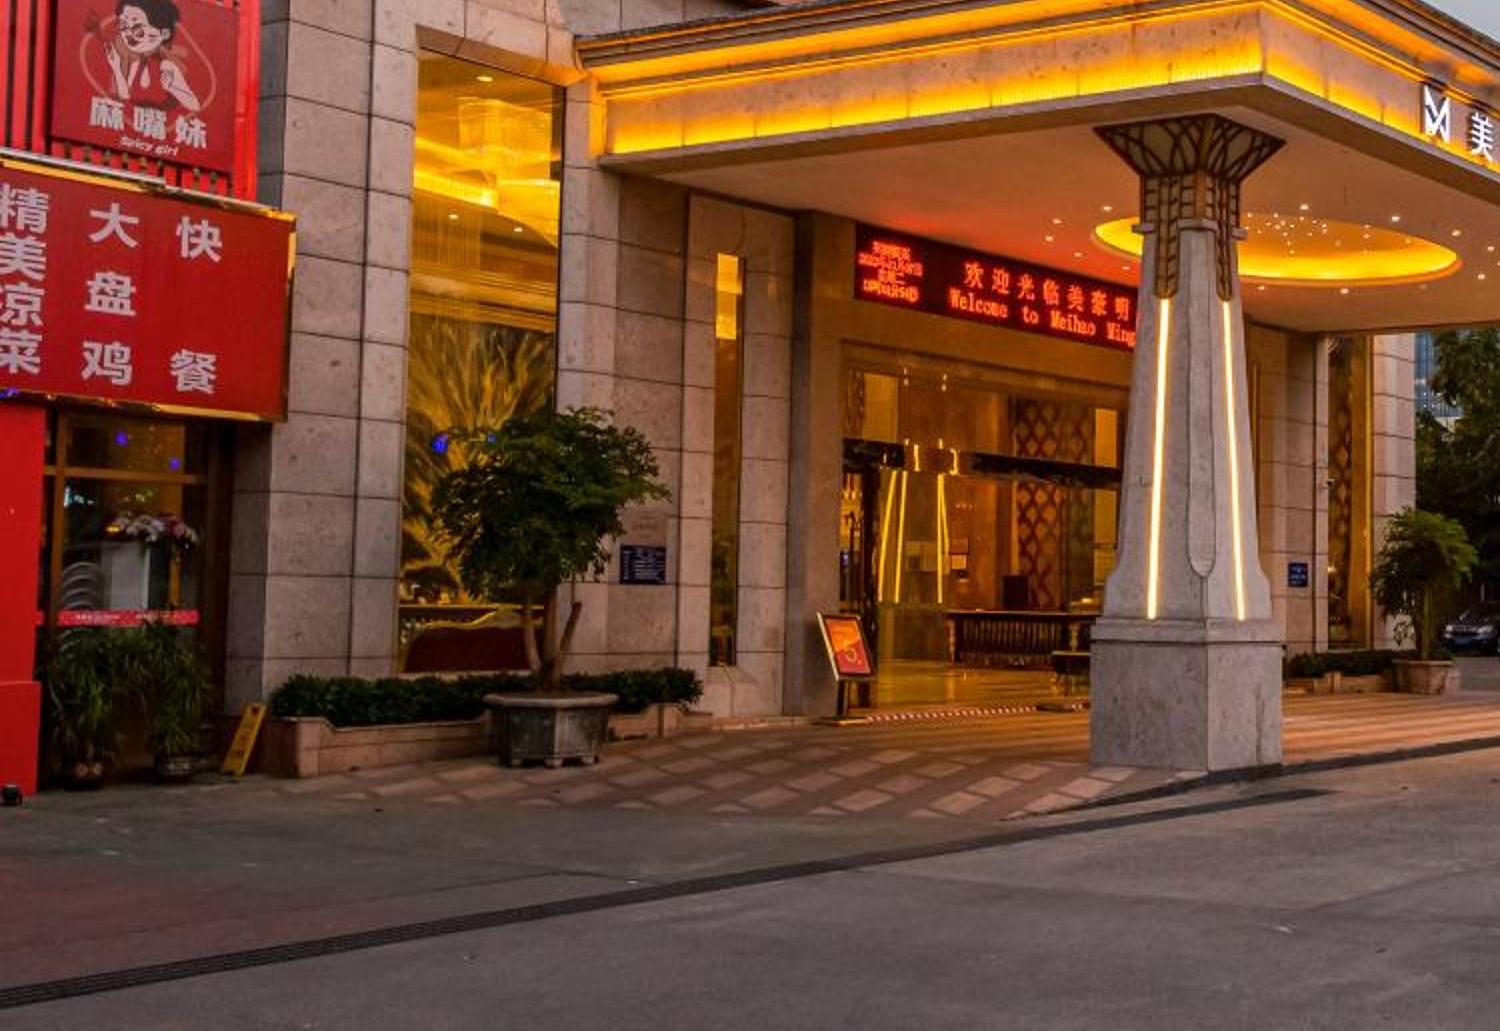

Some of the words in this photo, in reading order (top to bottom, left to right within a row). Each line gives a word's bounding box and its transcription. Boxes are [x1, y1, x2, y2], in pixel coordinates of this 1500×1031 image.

[81, 202, 140, 387] 大盘鸡
[168, 215, 224, 395] 快餐
[949, 287, 1009, 319] Welcome
[1022, 306, 1039, 324] to
[1051, 310, 1097, 337] Meihao
